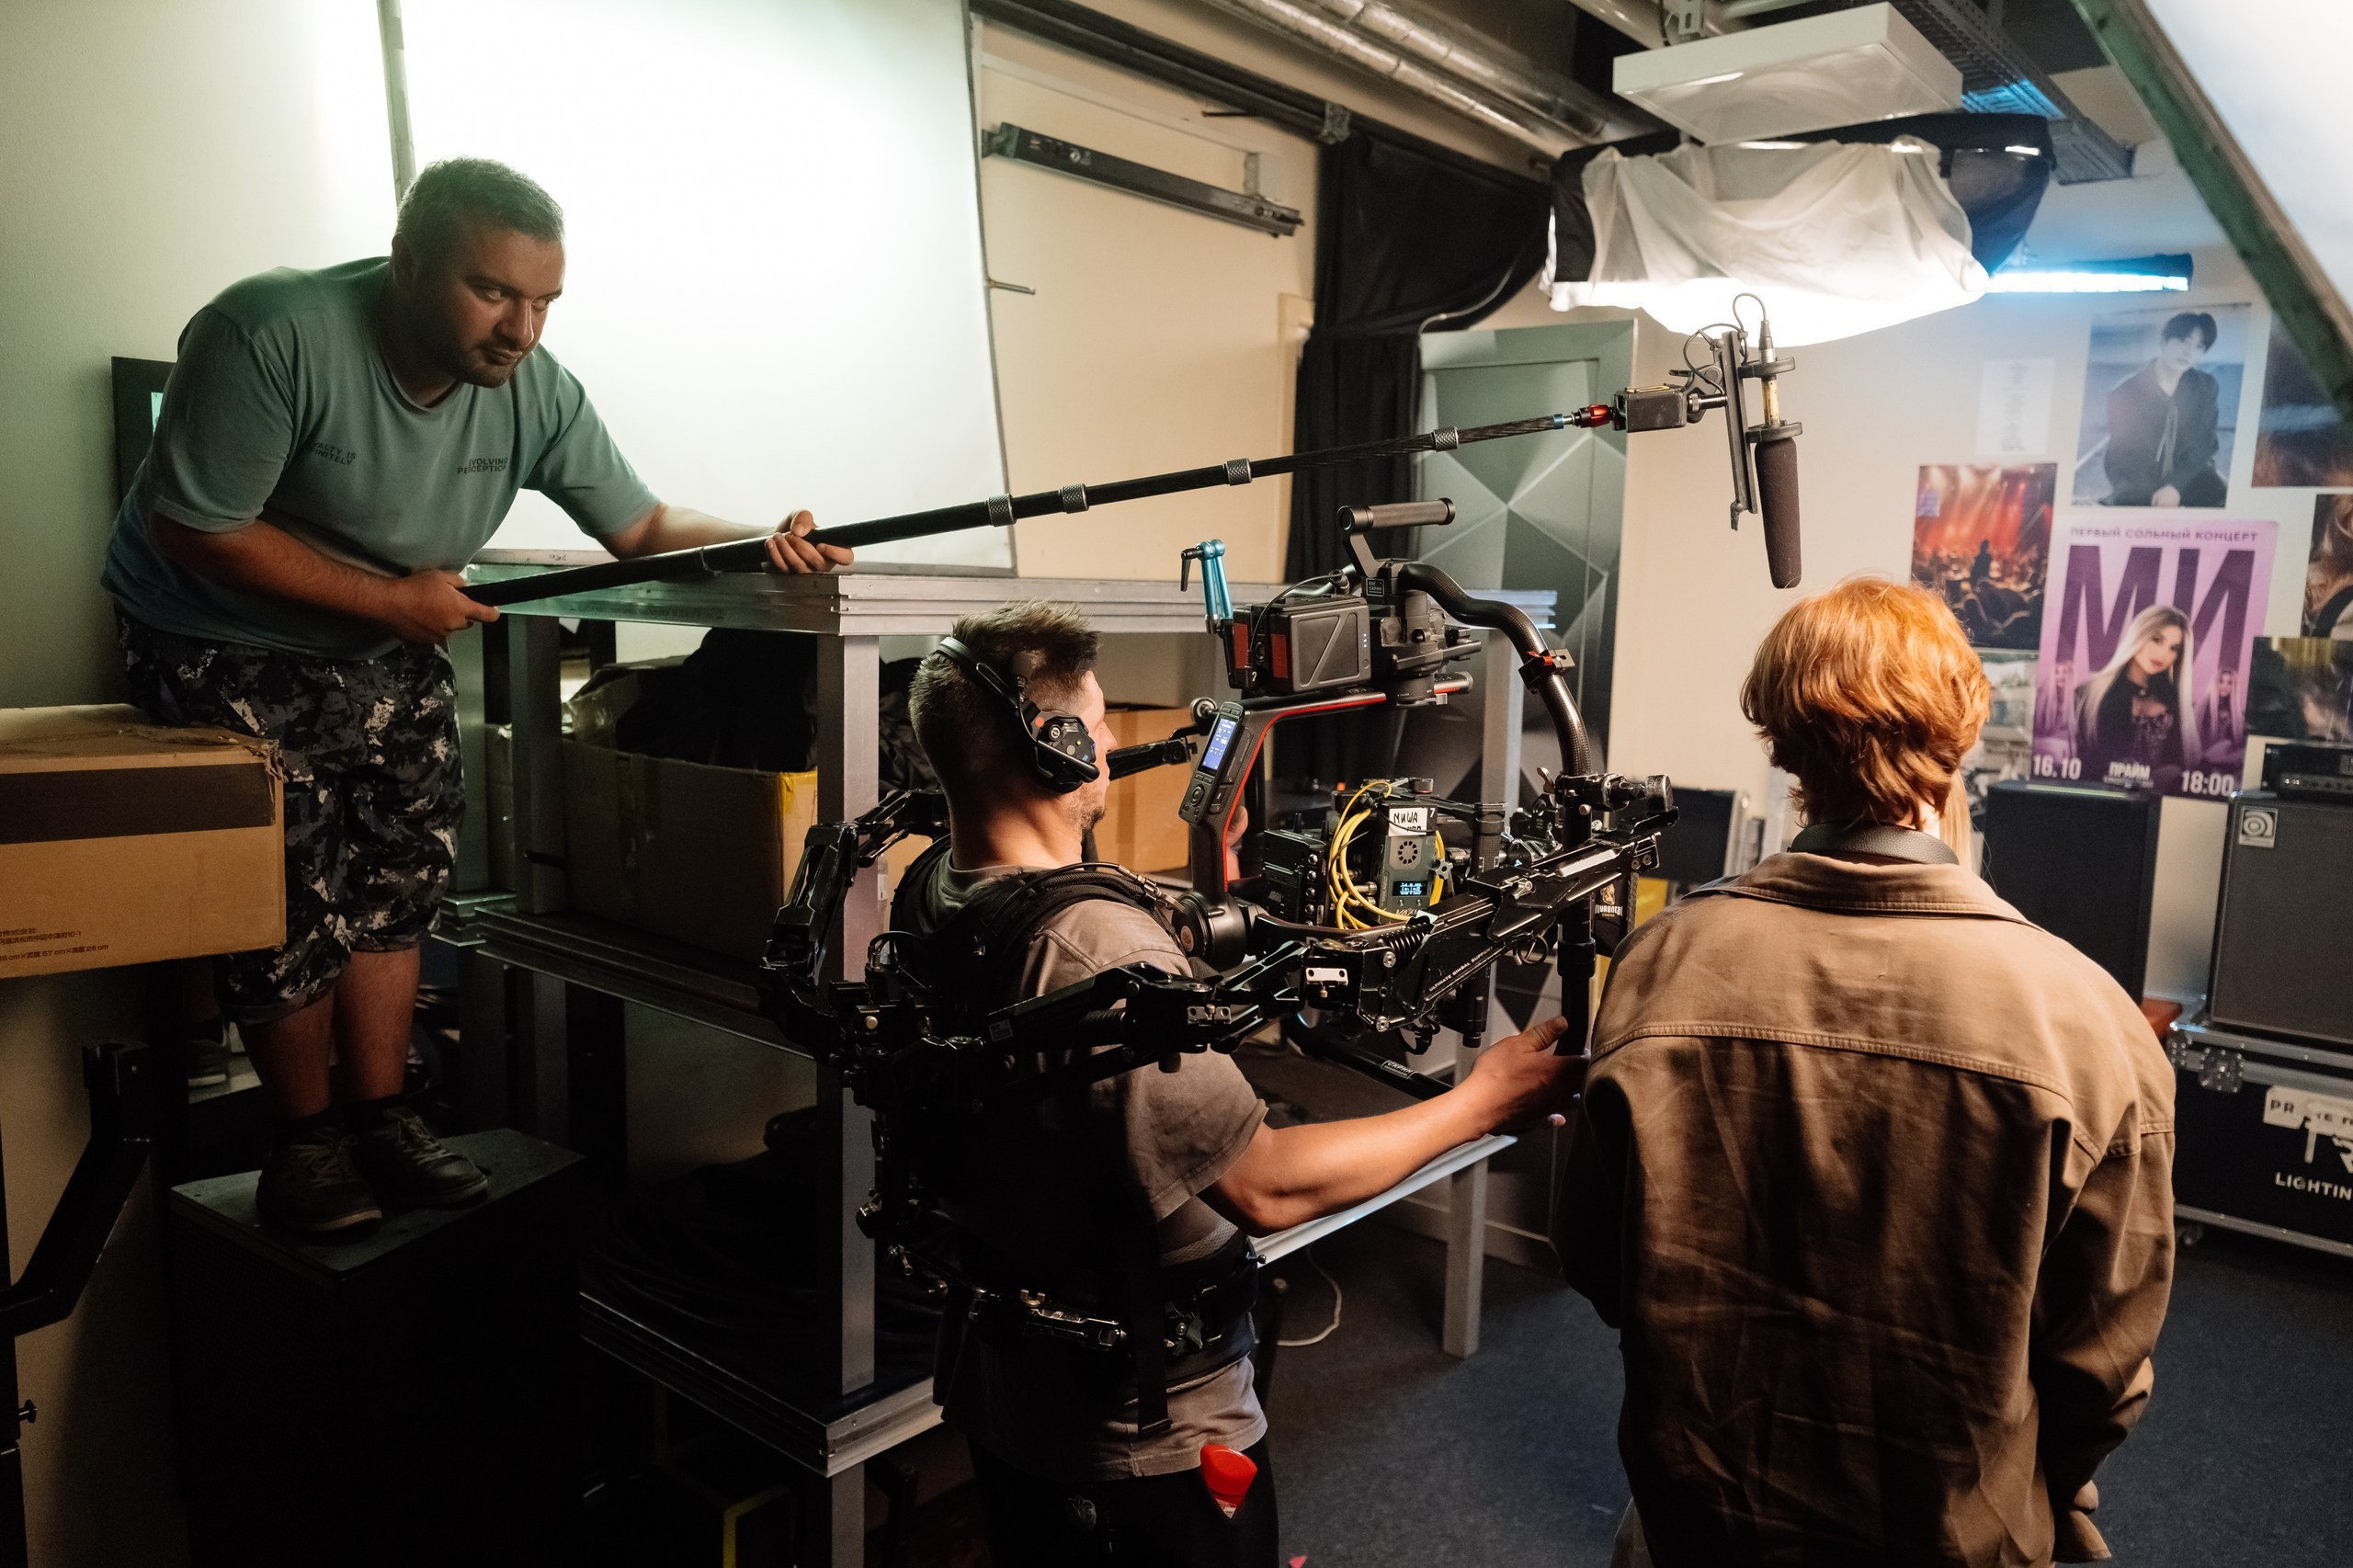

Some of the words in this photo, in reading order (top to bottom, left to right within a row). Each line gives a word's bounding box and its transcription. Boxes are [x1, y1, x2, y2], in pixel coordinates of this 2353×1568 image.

[313, 441, 343, 455] YALTY
[2070, 527, 2121, 538] ПЕРВЫЙ
[2125, 528, 2191, 540] СОЛЬНЫЙ
[2195, 531, 2259, 542] КОНЦЕРТ
[2032, 755, 2082, 780] 16.10
[2109, 761, 2151, 780] ПРАЙМ
[2182, 770, 2234, 797] 18:00
[1428, 973, 1452, 992] ULTIMATE
[1452, 962, 1472, 976] GIMBAL
